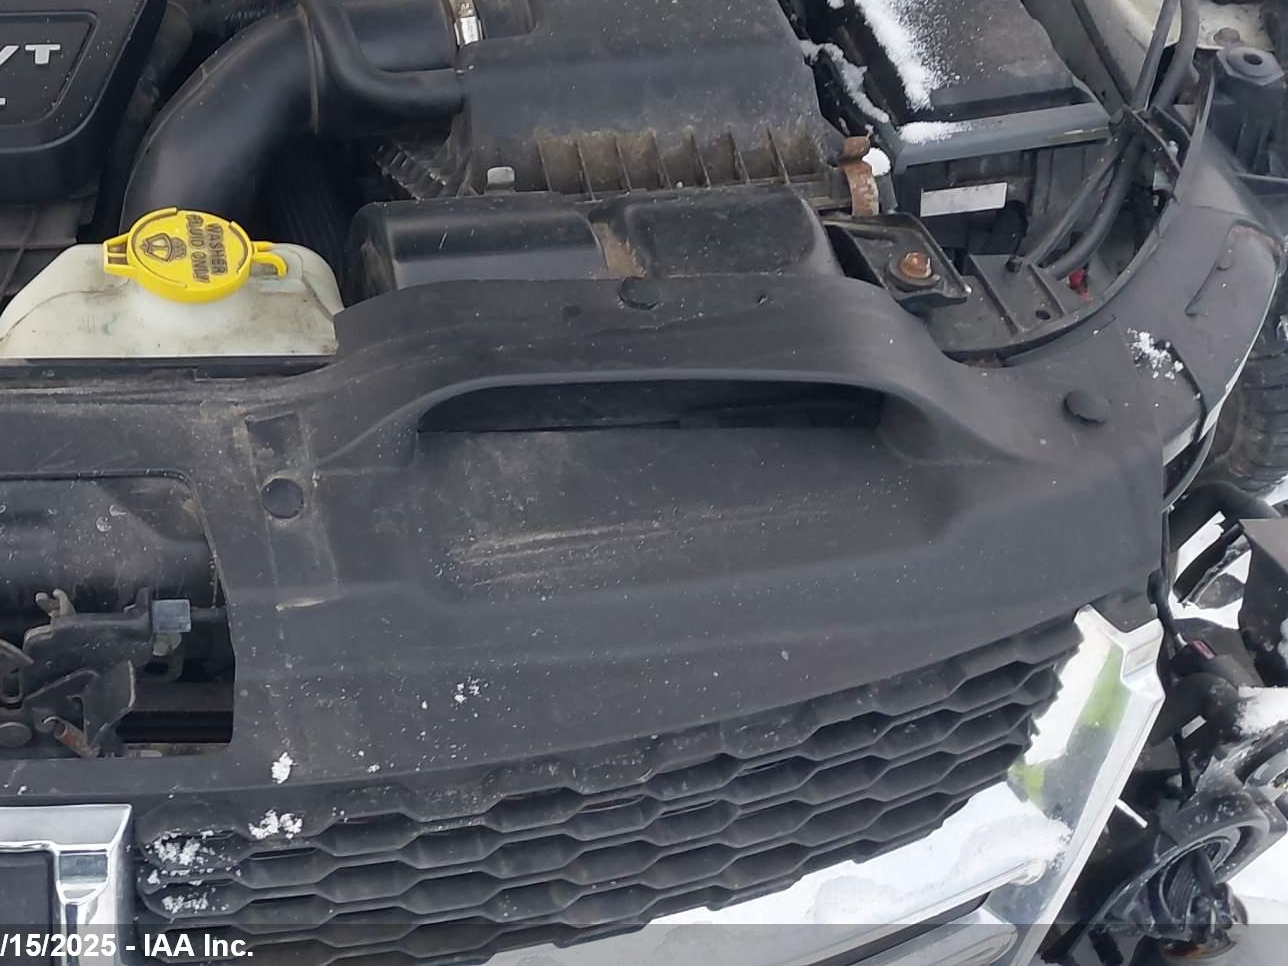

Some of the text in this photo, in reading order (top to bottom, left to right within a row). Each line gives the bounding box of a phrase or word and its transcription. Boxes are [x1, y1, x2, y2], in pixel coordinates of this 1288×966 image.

[187, 214, 209, 282] FLUID ONLY
[207, 223, 227, 275] WASHER
